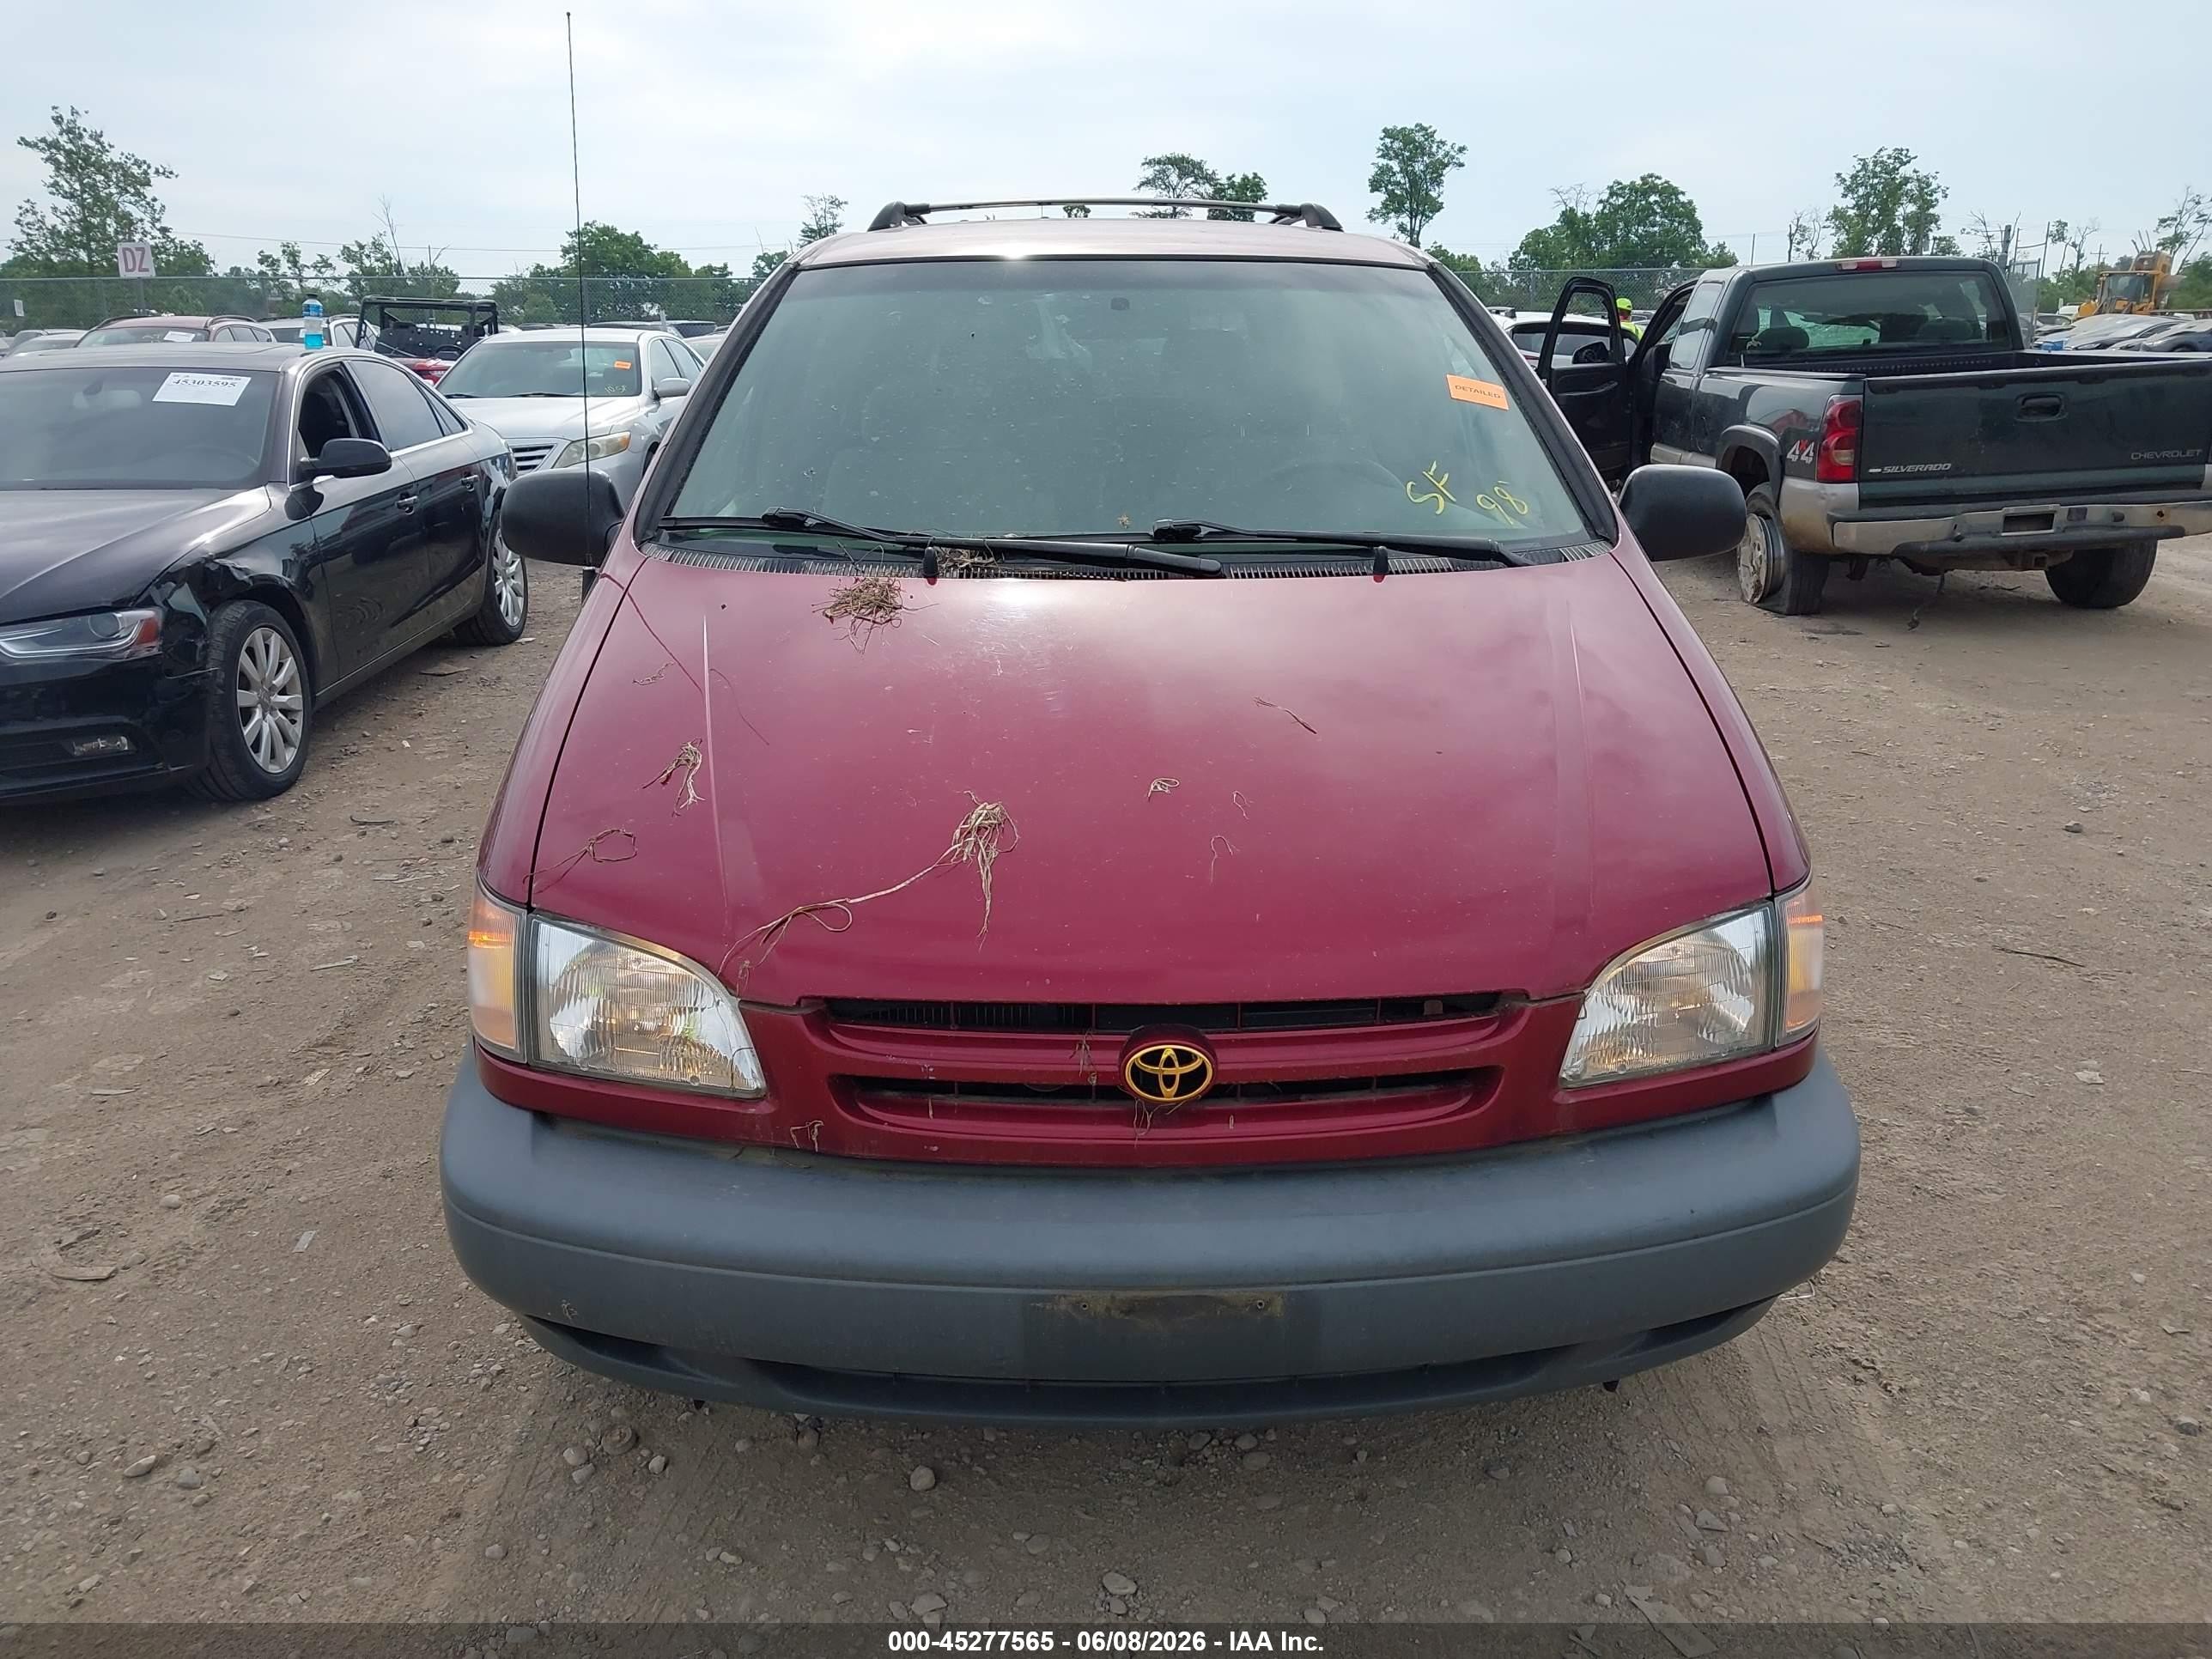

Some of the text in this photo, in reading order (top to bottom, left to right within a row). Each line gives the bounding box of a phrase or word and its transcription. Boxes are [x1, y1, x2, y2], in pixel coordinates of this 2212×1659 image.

[121, 246, 150, 273] DZ
[173, 379, 238, 388] 45303595
[1455, 385, 1501, 398] DETAILED
[2130, 449, 2203, 460] CHEVROLET
[1881, 463, 1952, 473] SILVERADO
